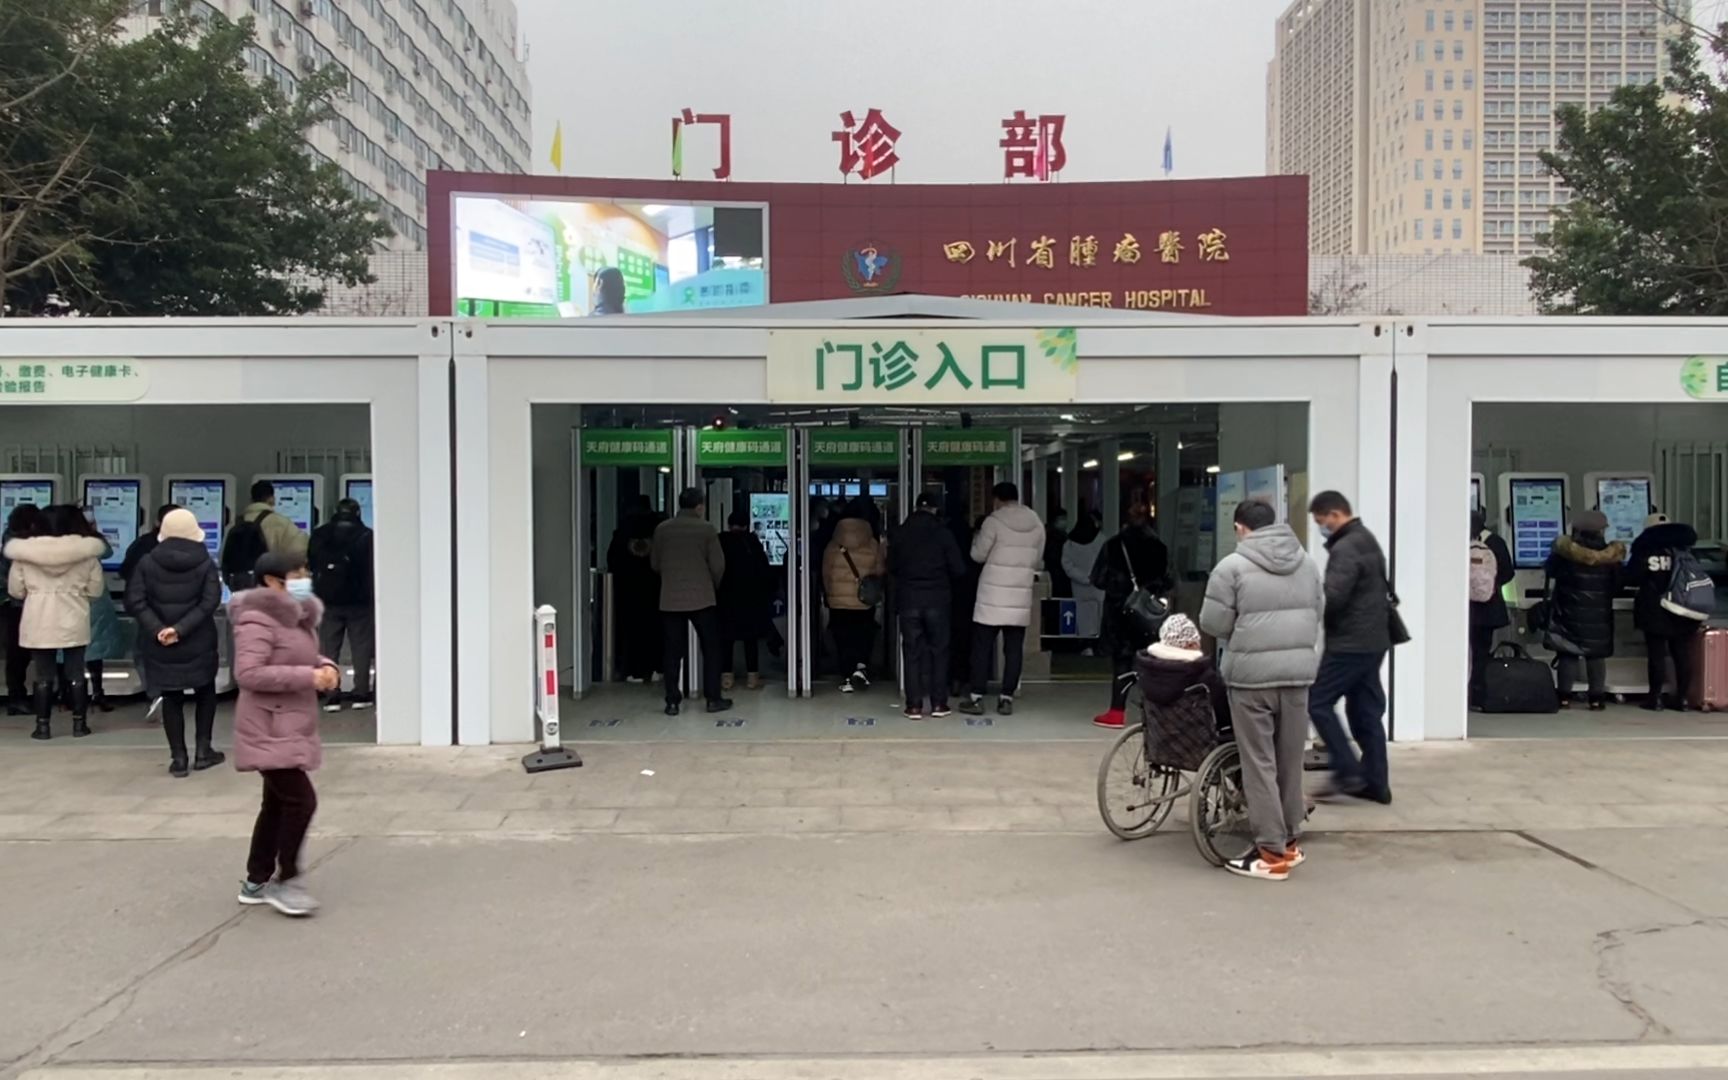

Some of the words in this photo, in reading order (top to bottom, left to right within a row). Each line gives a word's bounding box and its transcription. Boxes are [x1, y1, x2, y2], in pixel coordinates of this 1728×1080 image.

[671, 107, 1067, 182] 门诊部
[1124, 288, 1212, 308] HOSPITAL
[0, 364, 138, 378] 、缴费、电子健康卡、
[815, 340, 1026, 391] 门诊入口
[0, 380, 46, 393] 验报告
[586, 441, 668, 454] 天府健康码通道
[701, 441, 782, 454] 天府健康码通道
